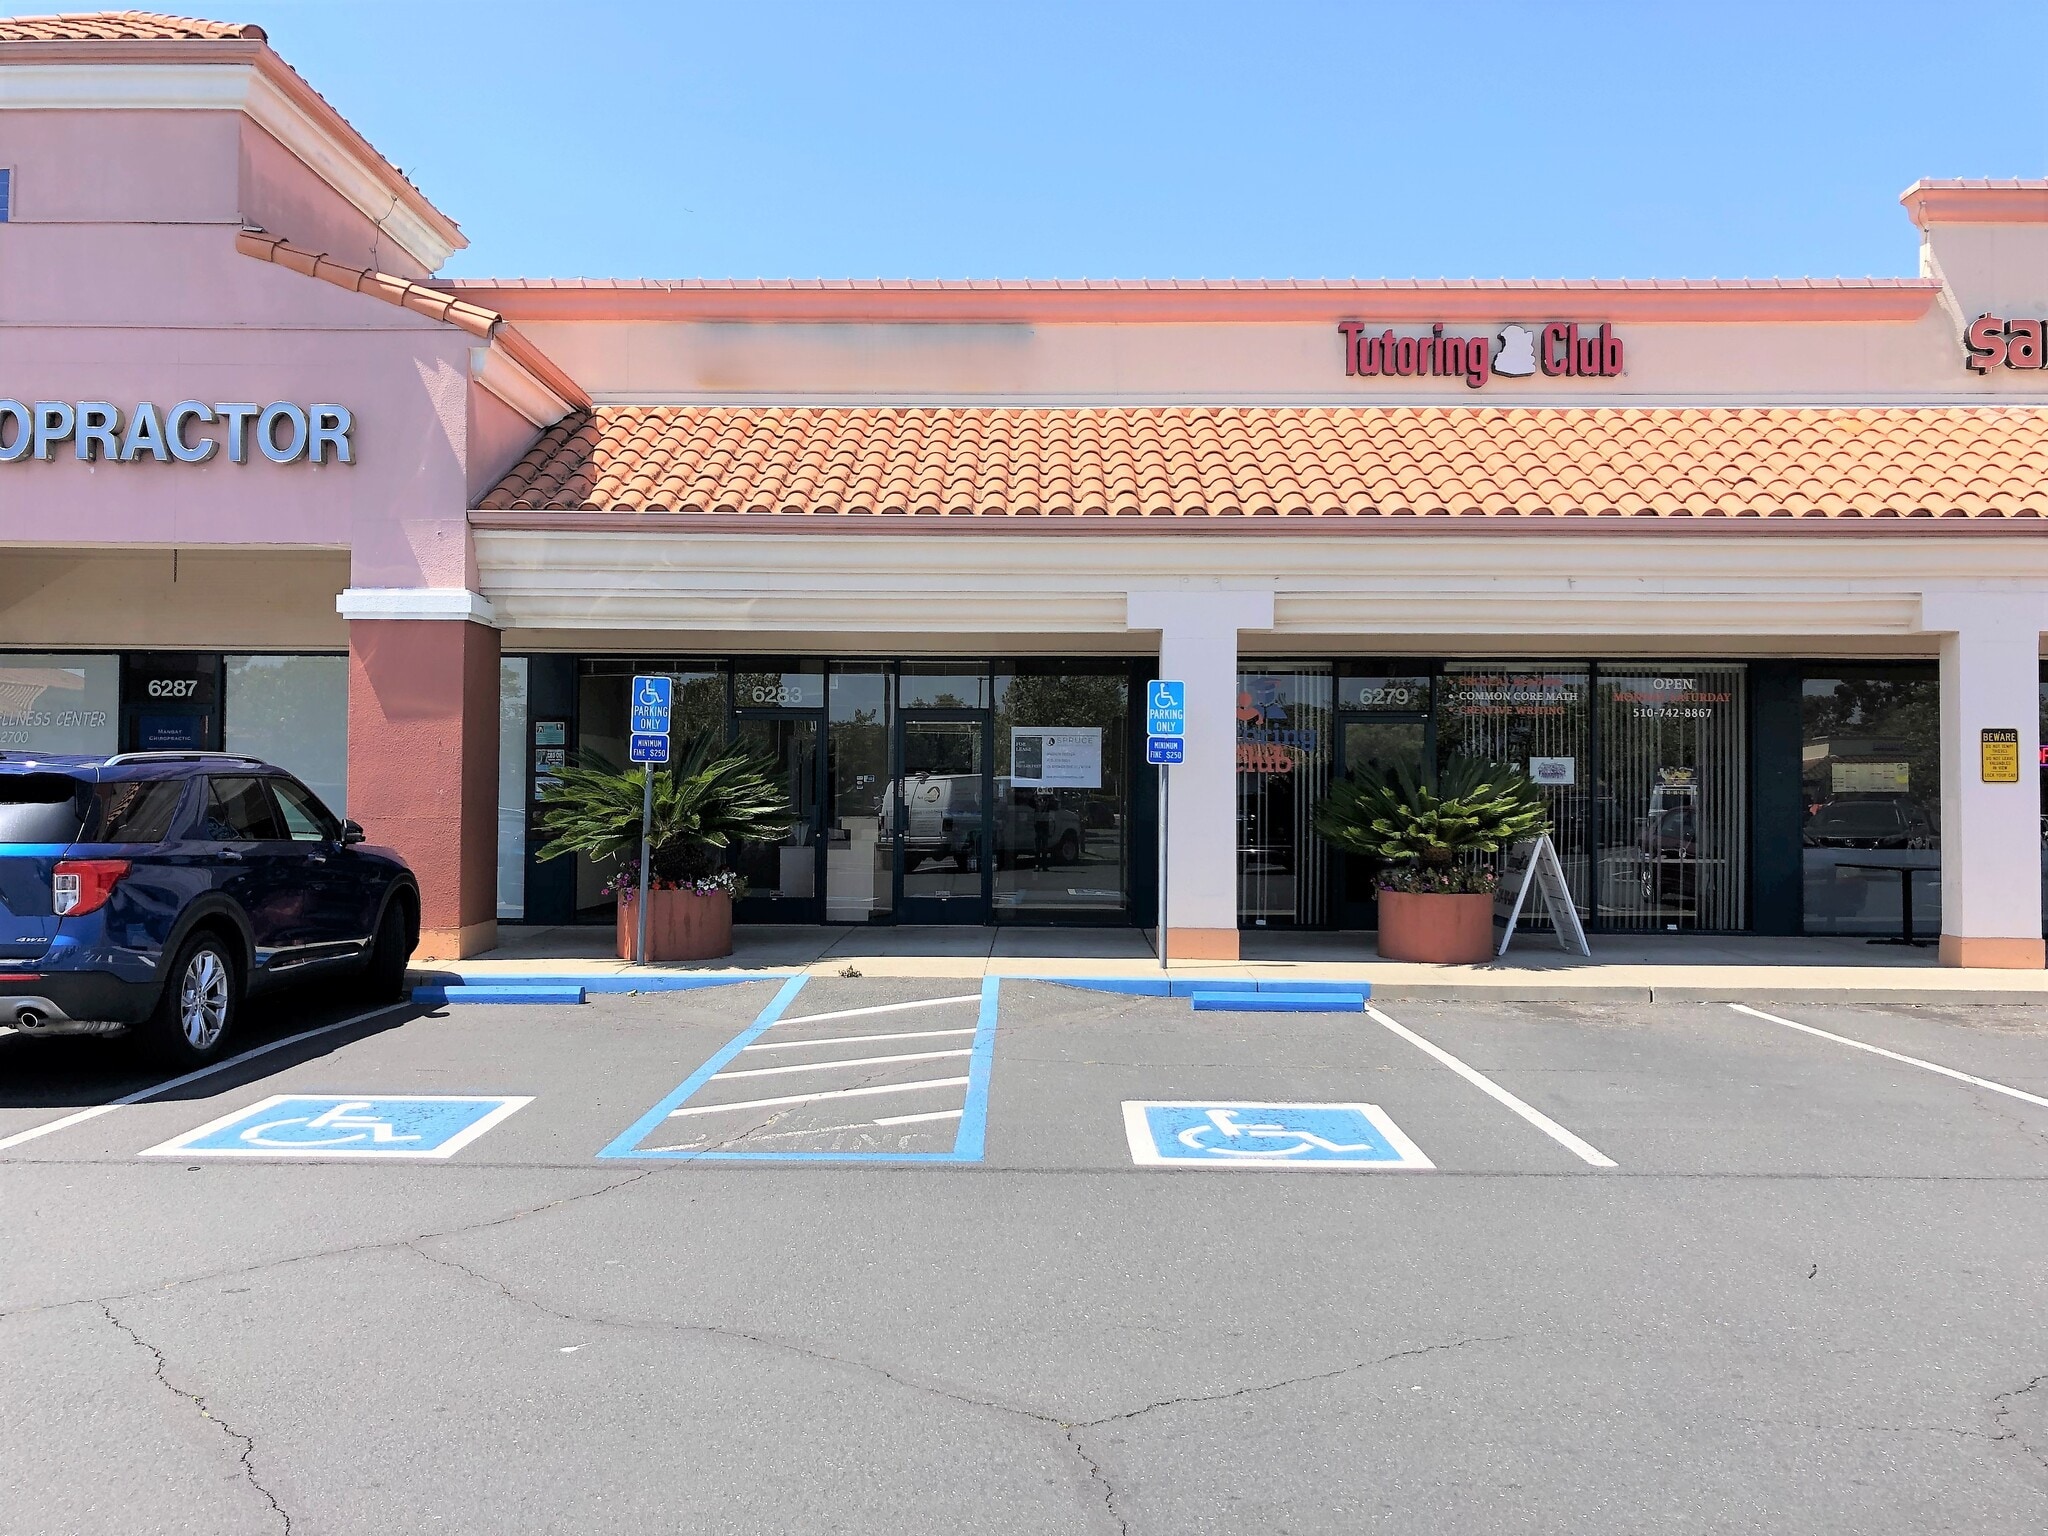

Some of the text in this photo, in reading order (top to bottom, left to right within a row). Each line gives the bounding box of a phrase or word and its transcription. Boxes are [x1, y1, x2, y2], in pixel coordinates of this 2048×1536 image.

[1964, 312, 2048, 375] $a
[1338, 322, 1624, 388] Tutoring Club
[148, 680, 198, 697] 6287
[1653, 679, 1693, 690] OPEN
[752, 686, 803, 703] 6283
[1360, 687, 1409, 705] 6279
[1460, 691, 1578, 701] COMMON CORE MATH
[634, 705, 668, 717] PARKING
[1150, 709, 1183, 720] PARKING
[1460, 706, 1565, 715] CREATIVE WRITING
[1633, 708, 1712, 718] 510-742-8867
[56, 711, 106, 727] CENTER
[640, 718, 660, 730] ONLY
[1156, 721, 1176, 732] ONLY
[1237, 722, 1317, 752] oring
[1983, 733, 2016, 741] BEWARE
[637, 740, 662, 748] MINIMUM
[1154, 741, 1178, 749] MINIMUM
[633, 749, 645, 757] FINE
[1166, 751, 1182, 759] $250
